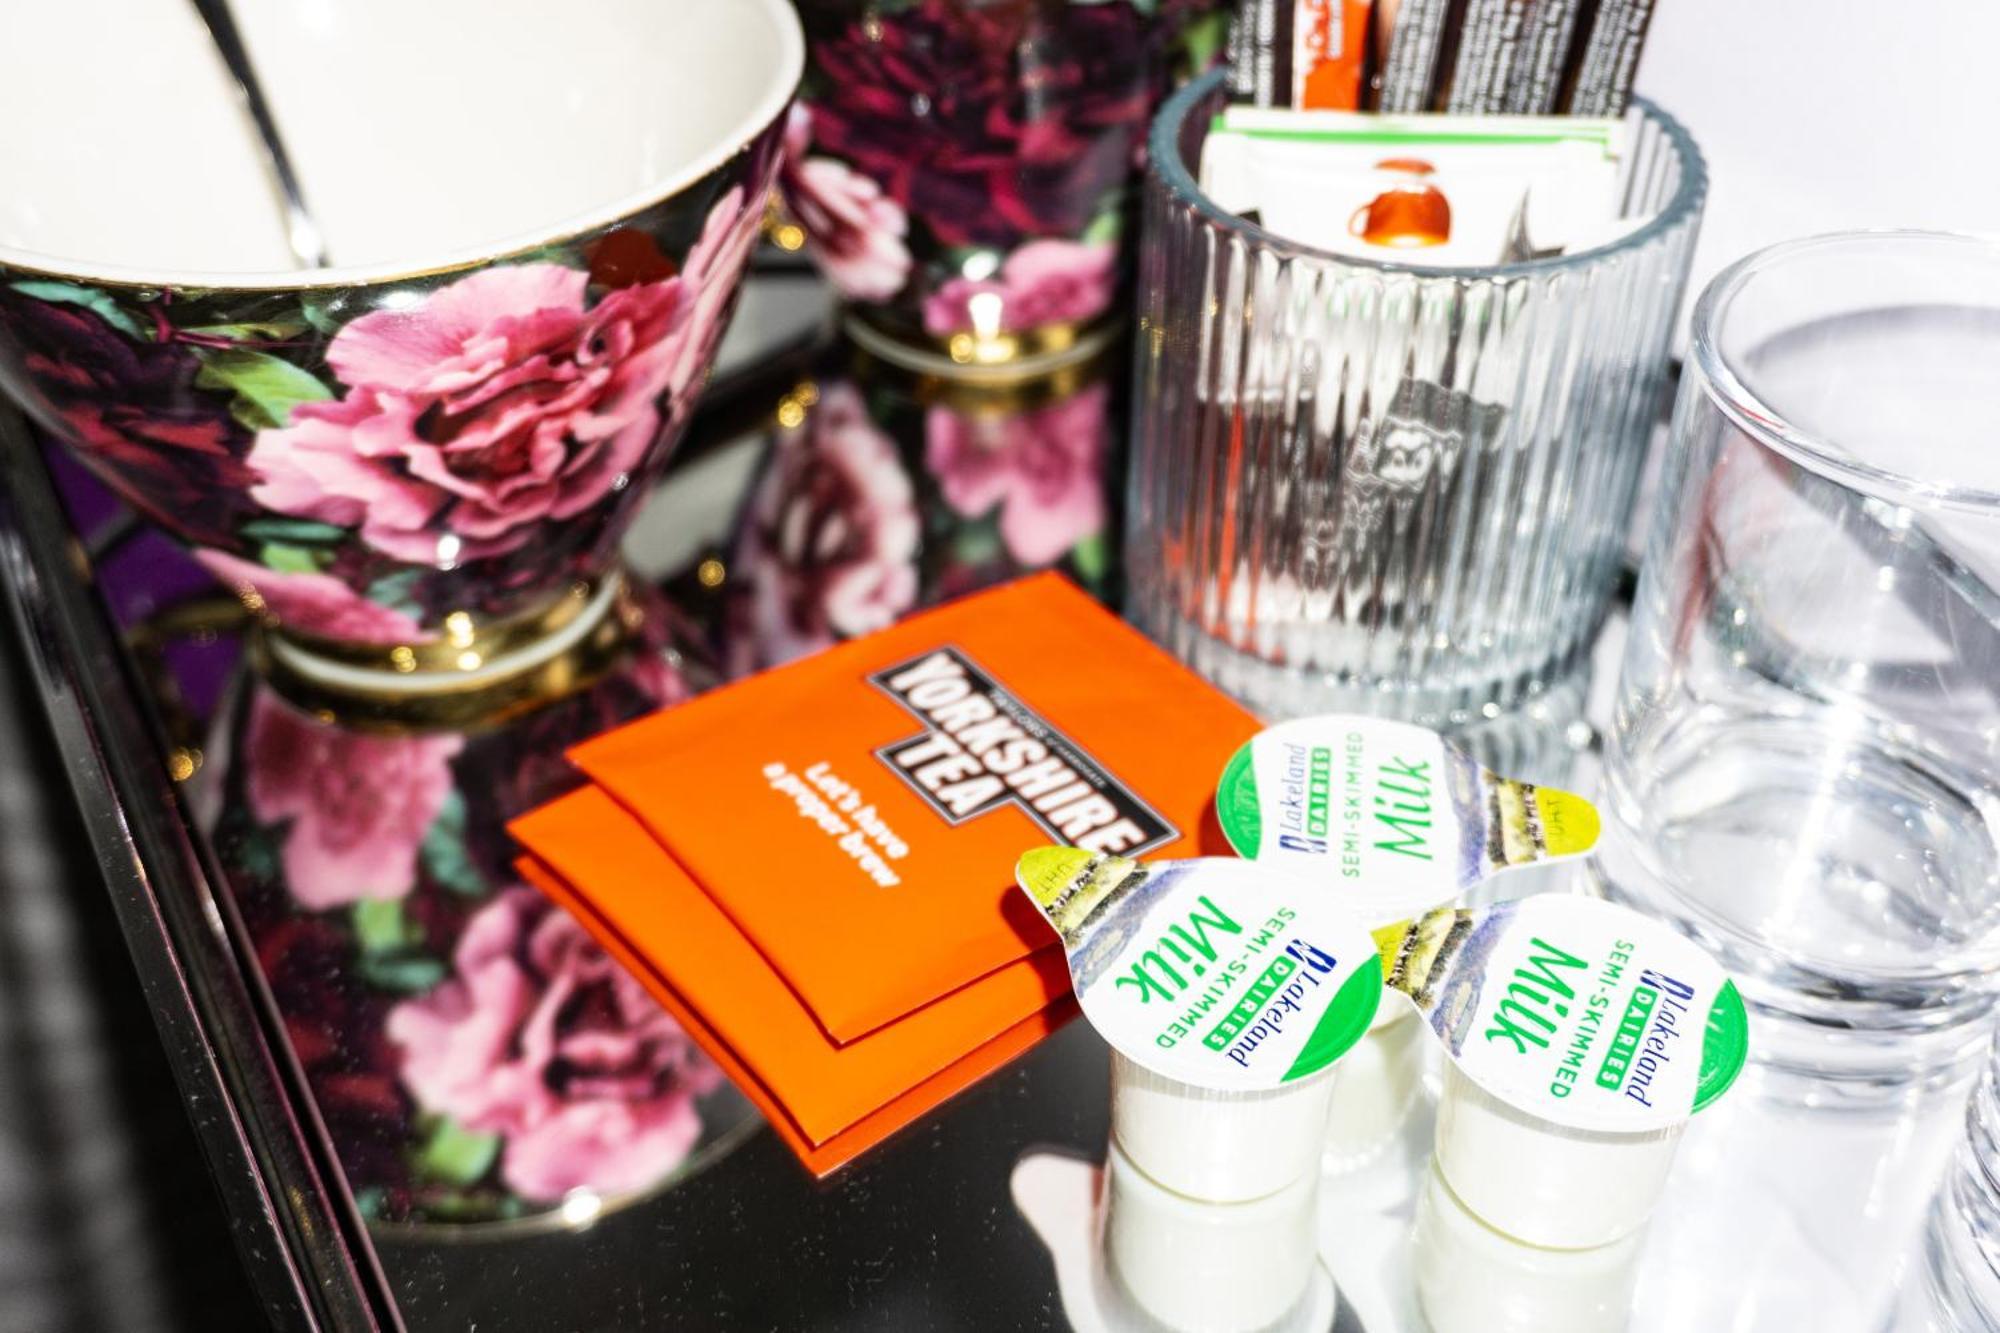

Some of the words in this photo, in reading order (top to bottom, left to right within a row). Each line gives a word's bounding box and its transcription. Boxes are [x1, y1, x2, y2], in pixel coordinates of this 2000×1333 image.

[762, 761, 787, 780] a
[889, 651, 1148, 858] YORKSHIRE
[894, 732, 1005, 816] TEA
[1281, 744, 1306, 833] Lakeland
[1309, 748, 1331, 835] DAIRIES
[770, 773, 850, 836] proper
[805, 761, 861, 812] Let's
[851, 804, 910, 860] have
[1342, 732, 1364, 878] SEMI-SKIMMED
[1374, 756, 1432, 861] Milk
[838, 831, 901, 888] brew
[1115, 896, 1243, 1004] Milk
[1156, 907, 1296, 1049] SEMI-SKIMMED
[1484, 936, 1588, 1055] Milk
[1209, 960, 1291, 1047] DAIRIES
[1226, 968, 1320, 1068] Lakeland
[1550, 939, 1635, 1098] SEMI-SKIMMED
[1599, 990, 1656, 1084] DAIRIES
[1625, 997, 1688, 1108] Lakeland
